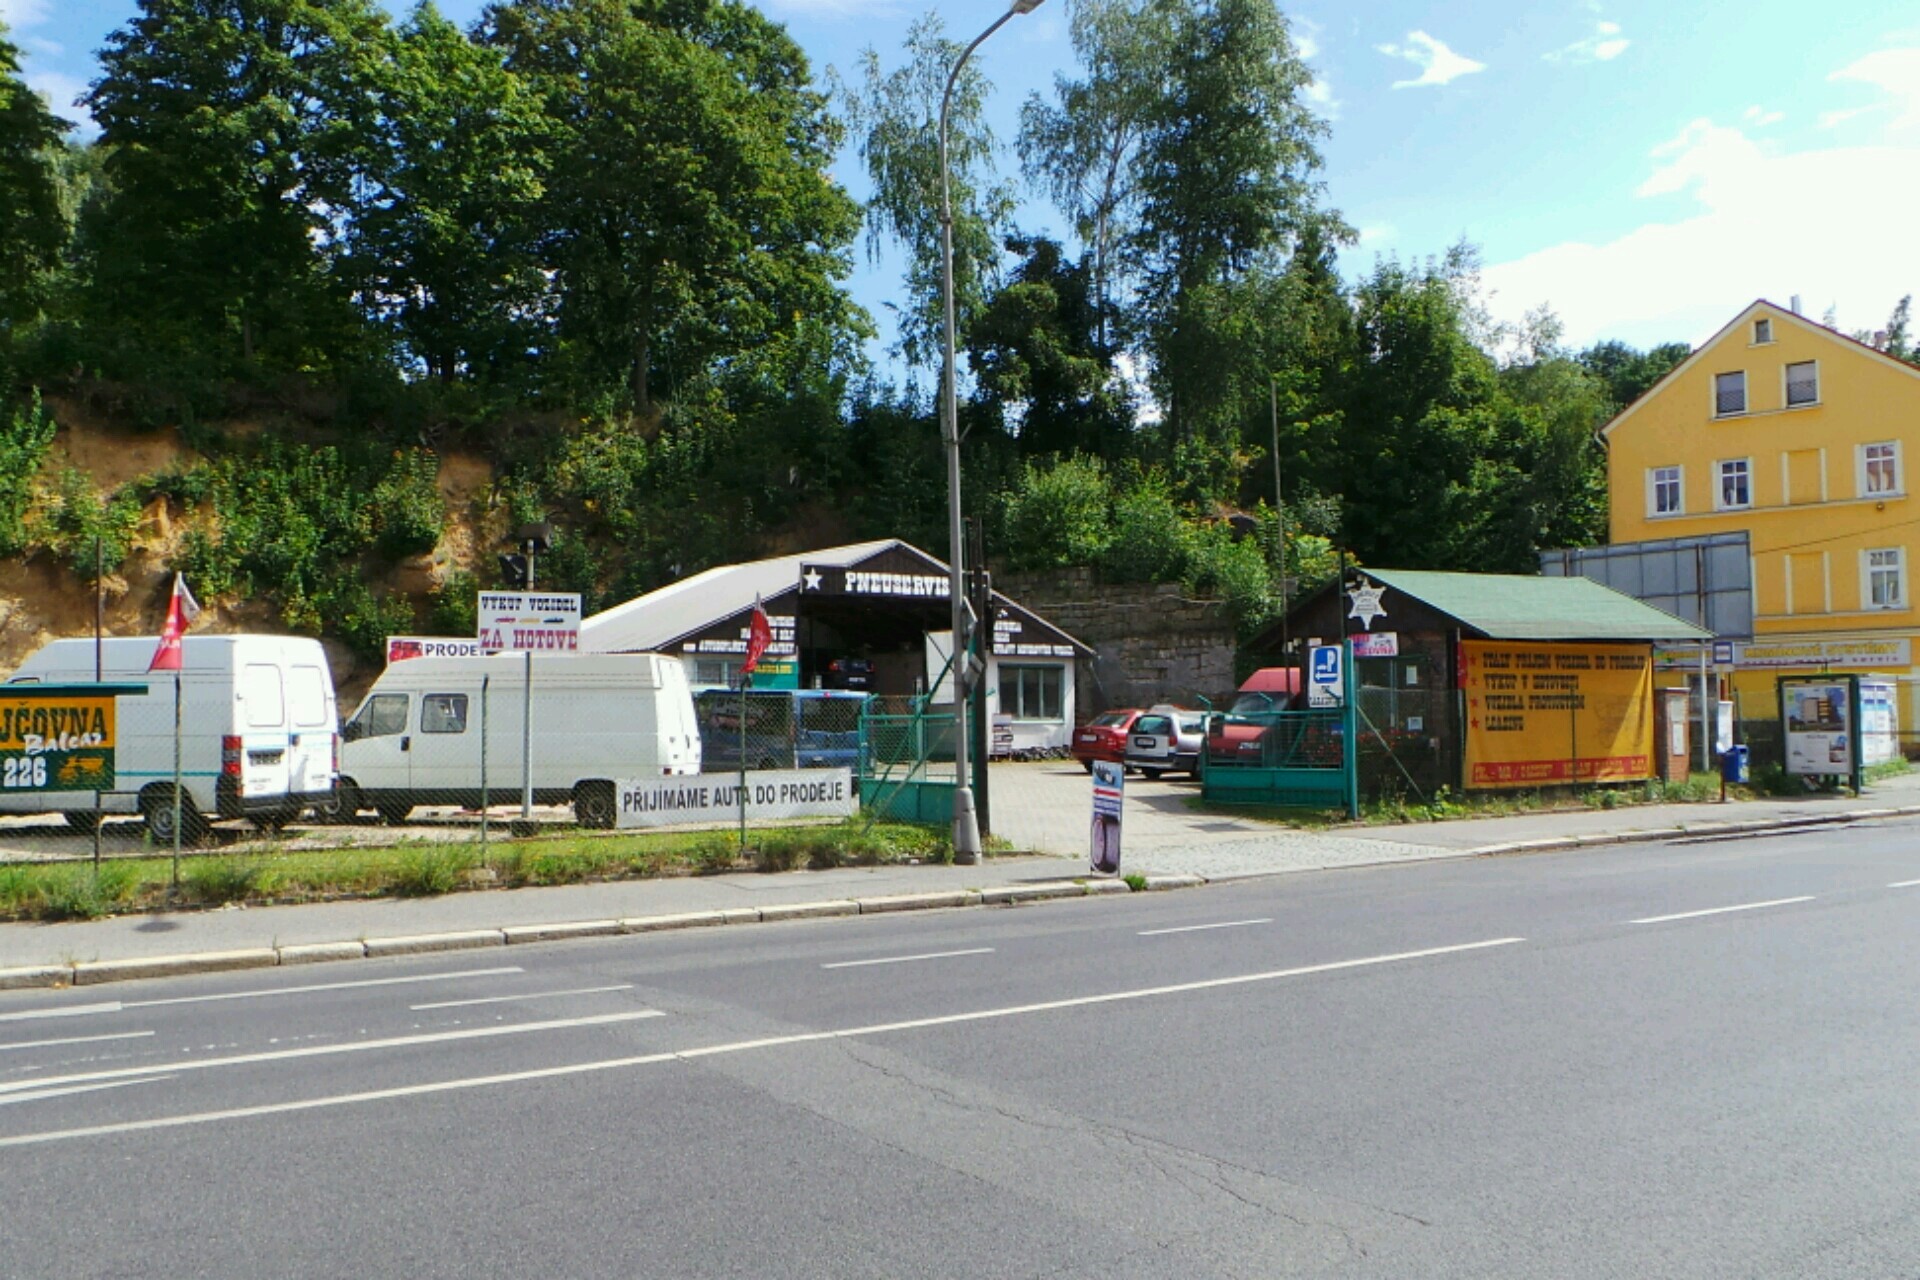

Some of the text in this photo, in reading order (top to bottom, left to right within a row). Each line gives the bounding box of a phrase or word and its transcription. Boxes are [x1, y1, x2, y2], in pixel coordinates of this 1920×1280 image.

[845, 571, 950, 597] PNEUSERVIS
[480, 628, 503, 649] ZA
[3, 756, 47, 787] 226
[713, 785, 750, 806] AUTA
[756, 784, 775, 804] DO
[781, 781, 842, 803] PRODEJE
